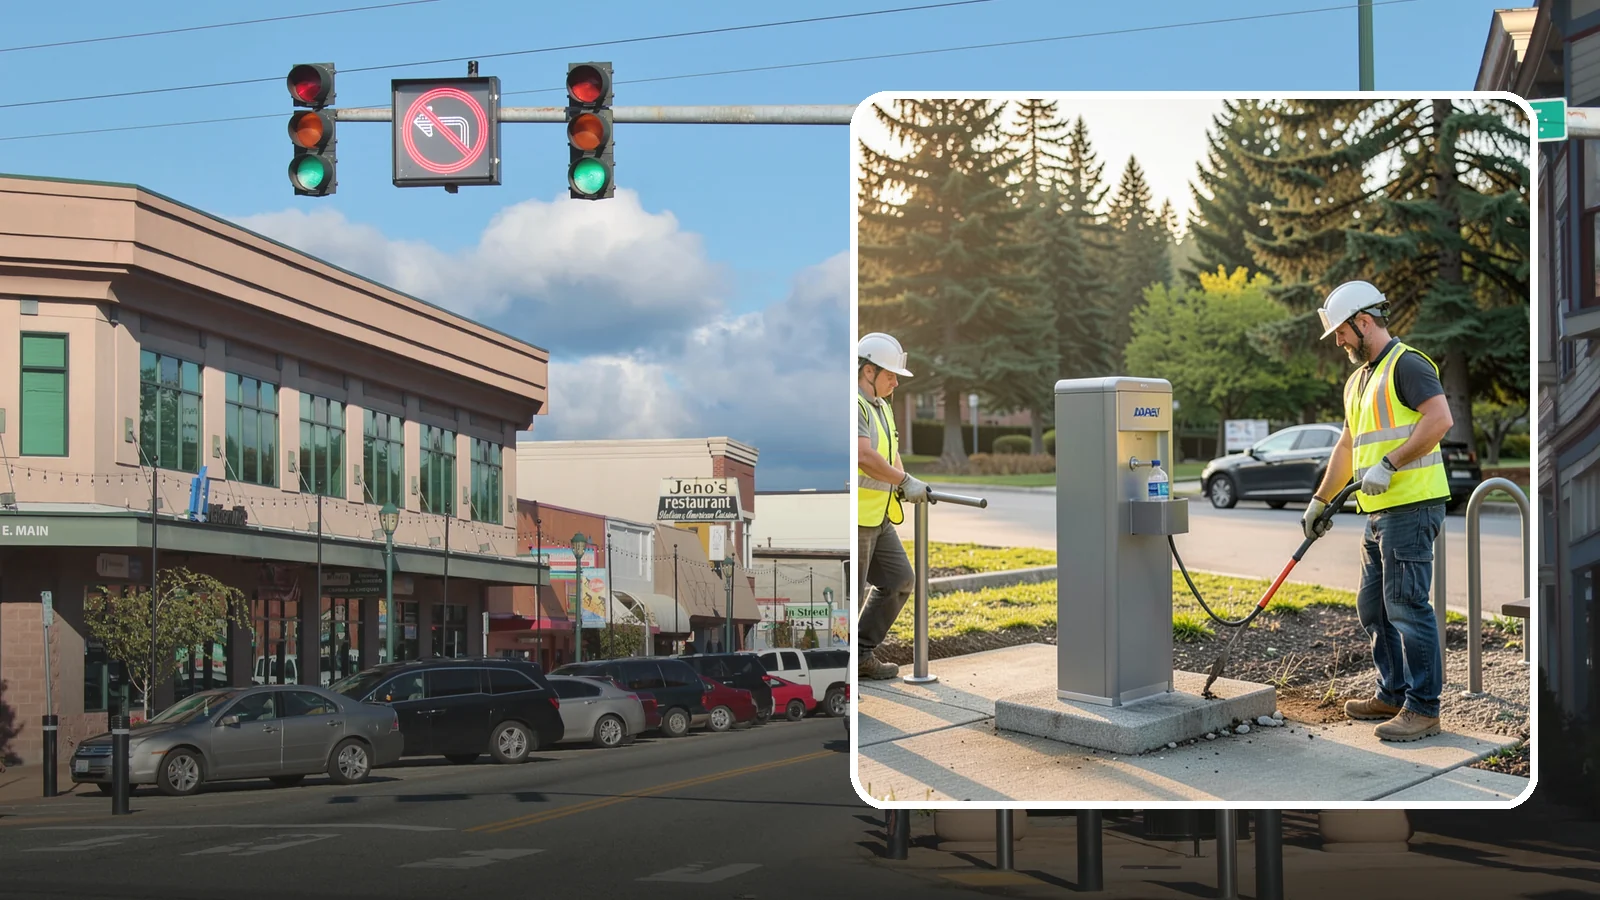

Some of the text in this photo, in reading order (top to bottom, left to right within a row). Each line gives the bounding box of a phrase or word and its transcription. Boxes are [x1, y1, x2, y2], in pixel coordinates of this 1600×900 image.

[669, 480, 727, 494] Jeno's
[665, 496, 731, 509] restaurant
[685, 510, 714, 519] American
[714, 510, 738, 519] Cuisine
[2, 525, 49, 536] E. MAIN
[797, 608, 828, 617] Street
